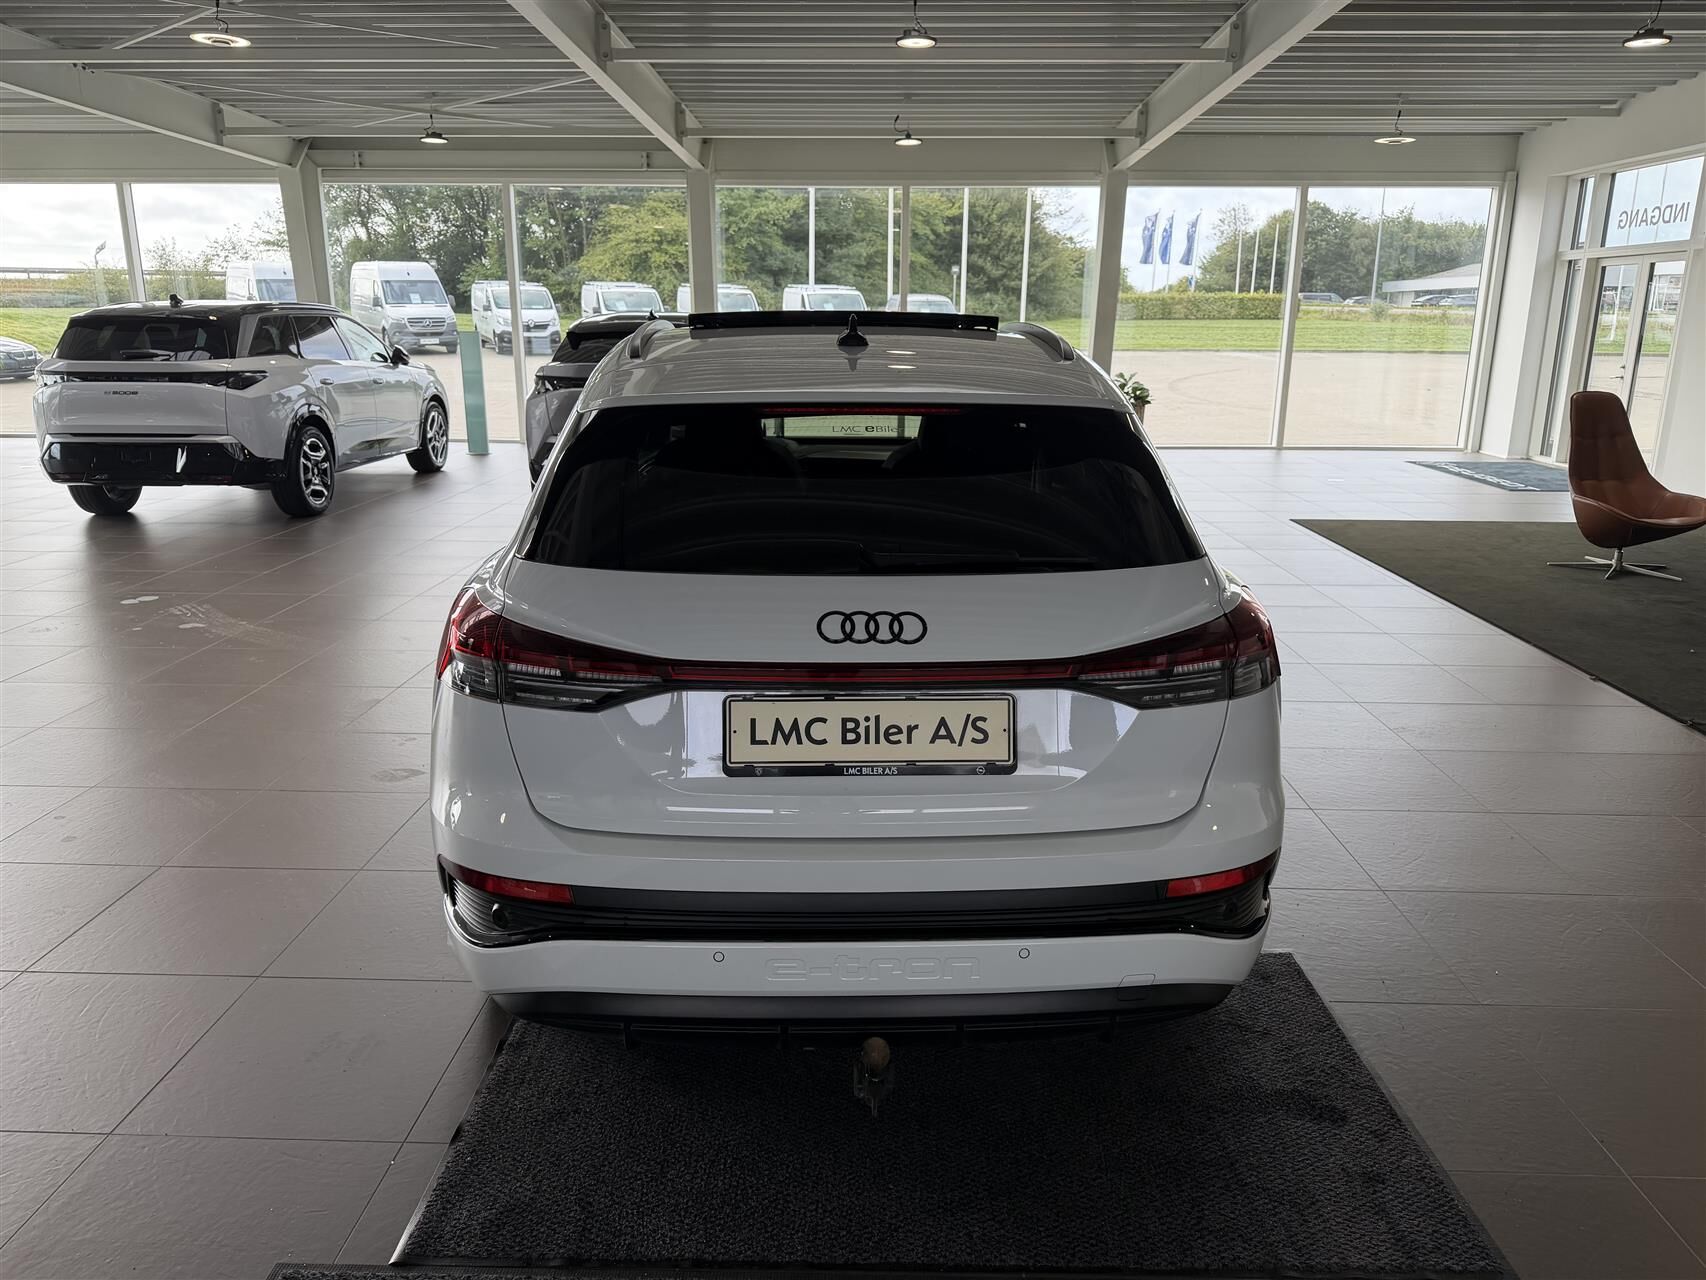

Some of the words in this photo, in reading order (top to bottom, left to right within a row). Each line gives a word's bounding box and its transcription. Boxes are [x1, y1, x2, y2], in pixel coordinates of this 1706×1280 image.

[832, 425, 862, 433] LMC
[865, 425, 904, 433] eBile
[749, 717, 829, 746] LMC
[840, 714, 920, 746] Biler
[928, 713, 990, 748] A/S
[843, 767, 861, 775] LMC
[862, 767, 884, 775] BILER
[884, 766, 898, 775] A/S
[765, 954, 981, 981] e-tron
